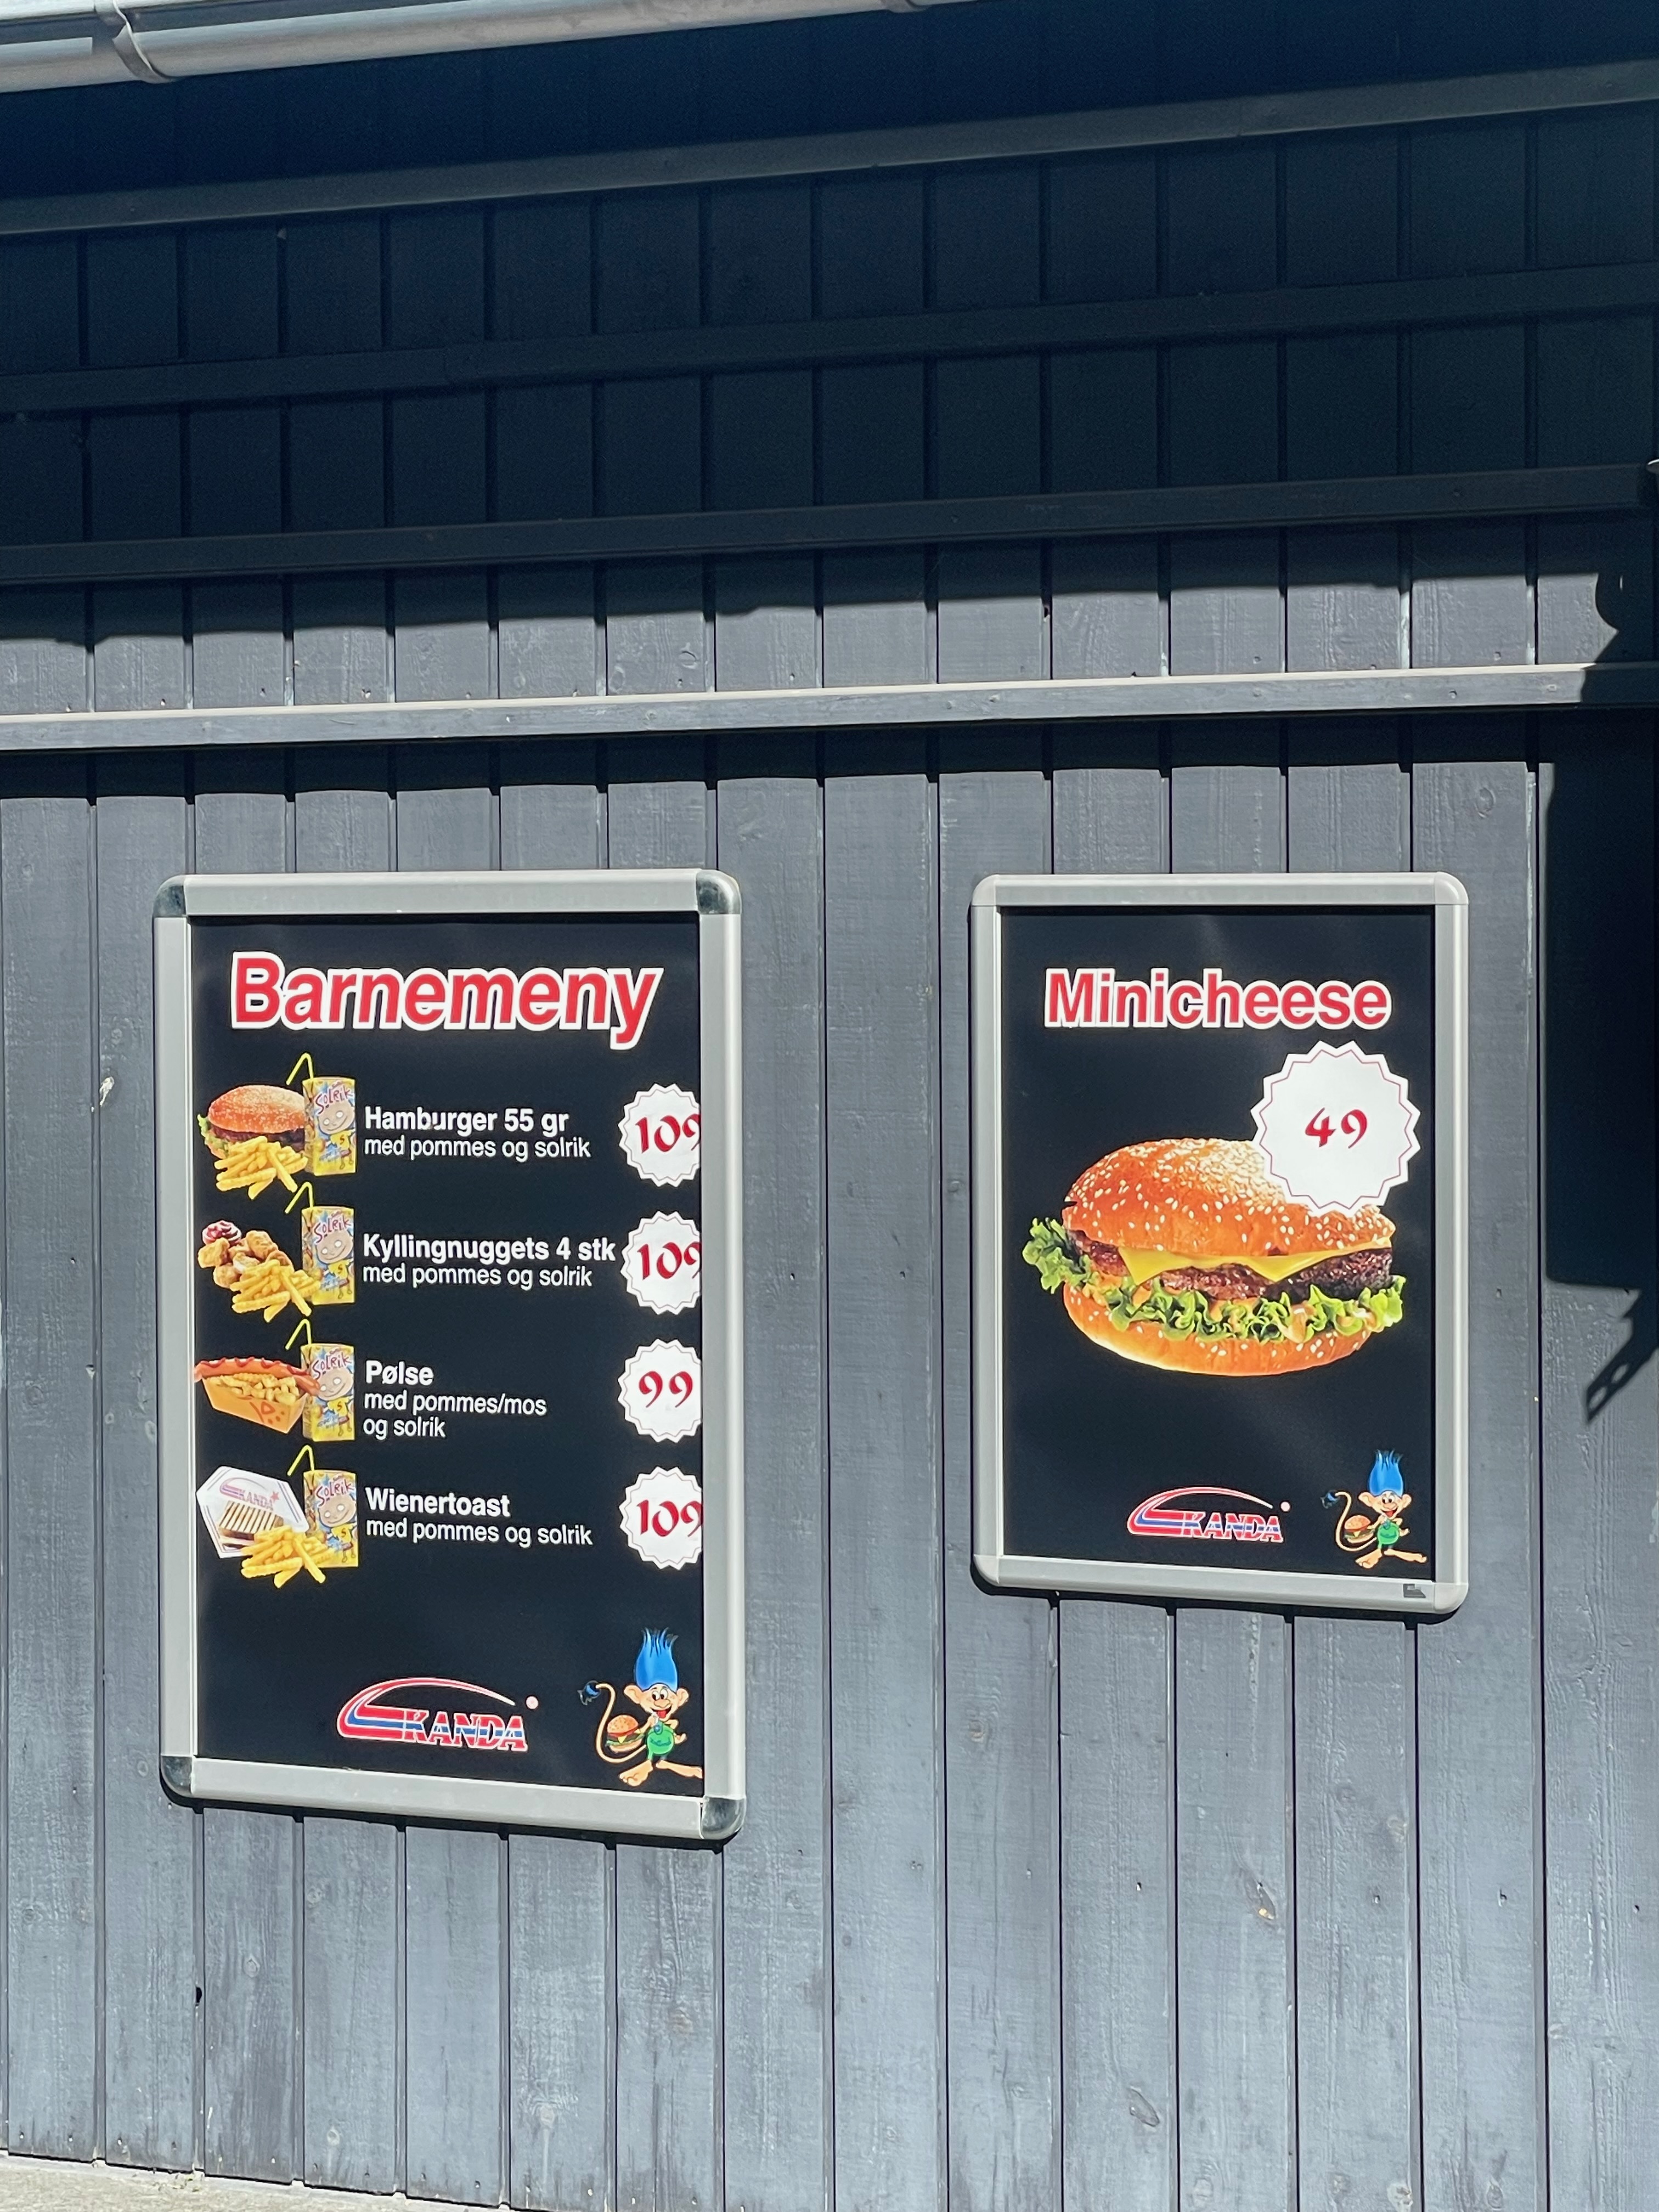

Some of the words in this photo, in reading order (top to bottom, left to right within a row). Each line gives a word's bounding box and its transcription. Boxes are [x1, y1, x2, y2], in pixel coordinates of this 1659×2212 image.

[230, 951, 664, 1051] Barnemeny
[1044, 968, 1392, 1030] Minicheese
[365, 1106, 498, 1138] Hamburger
[504, 1108, 534, 1132] 55
[541, 1113, 569, 1138] gr
[1305, 1108, 1368, 1149] 49
[364, 1135, 405, 1156] med
[410, 1139, 496, 1160] pommes
[501, 1141, 528, 1163] og
[534, 1136, 591, 1158] solrik
[363, 1233, 549, 1266] Kyllingnuggets
[556, 1237, 572, 1260] 4
[578, 1237, 616, 1261] stk
[363, 1262, 405, 1283] med
[412, 1267, 501, 1288] pommes
[507, 1269, 533, 1291] og
[539, 1265, 592, 1286] solrik
[366, 1360, 434, 1386] Pølse
[639, 1370, 693, 1408] 99
[364, 1390, 407, 1411] med
[413, 1393, 547, 1416] pommes/mos
[363, 1418, 388, 1441] og
[393, 1416, 446, 1438] solrik
[365, 1487, 511, 1517] Wienertoast
[636, 1499, 703, 1537] 109
[366, 1517, 407, 1538] med
[413, 1522, 500, 1543] pommes
[505, 1526, 532, 1548] og
[537, 1524, 593, 1545] solrik
[1182, 1511, 1284, 1543] KANDA
[403, 1709, 528, 1752] KANDA
